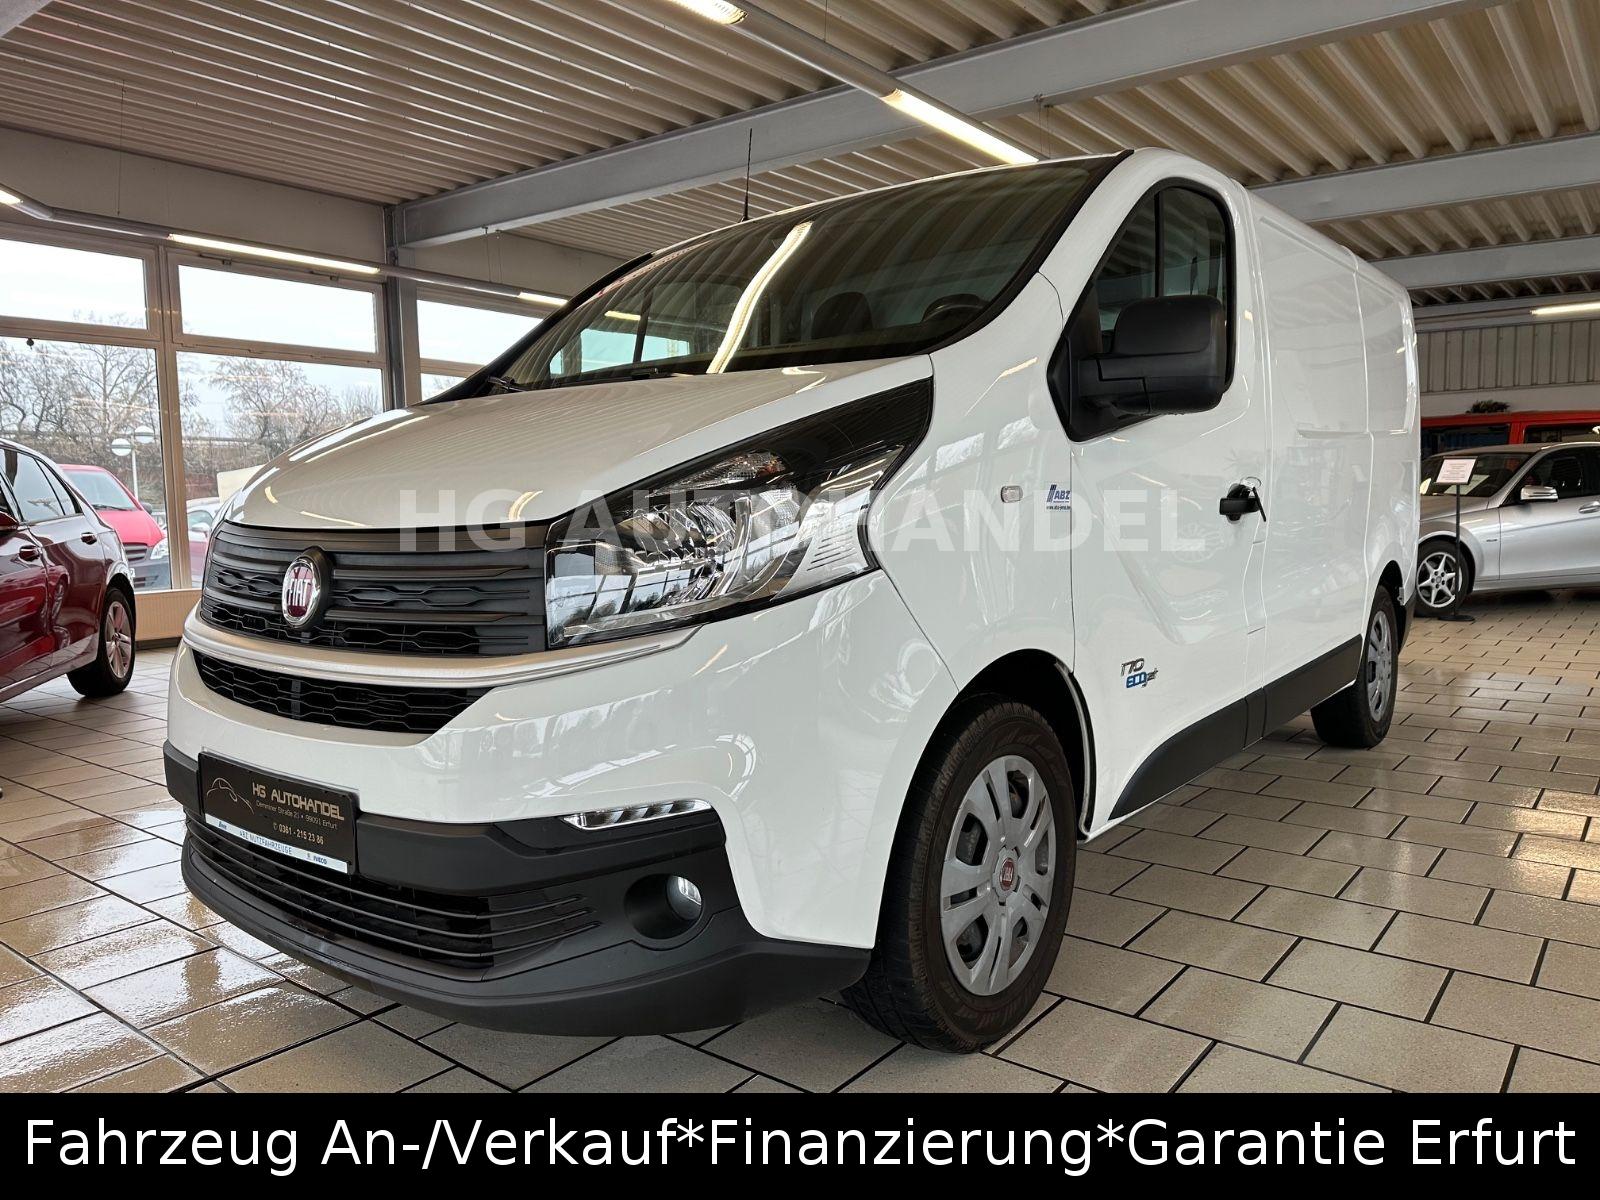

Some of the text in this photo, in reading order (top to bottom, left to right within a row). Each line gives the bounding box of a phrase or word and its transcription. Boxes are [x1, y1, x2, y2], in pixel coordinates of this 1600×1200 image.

[1053, 489, 1071, 500] ABZ
[288, 578, 312, 607] FIAT
[252, 782, 345, 821] HG AUTOHANDEL
[278, 823, 293, 835] 0361
[296, 829, 307, 840] 215
[308, 832, 316, 842] 23
[322, 819, 338, 830] Erfurt
[249, 833, 293, 855] NUTZFAHRZEUGE
